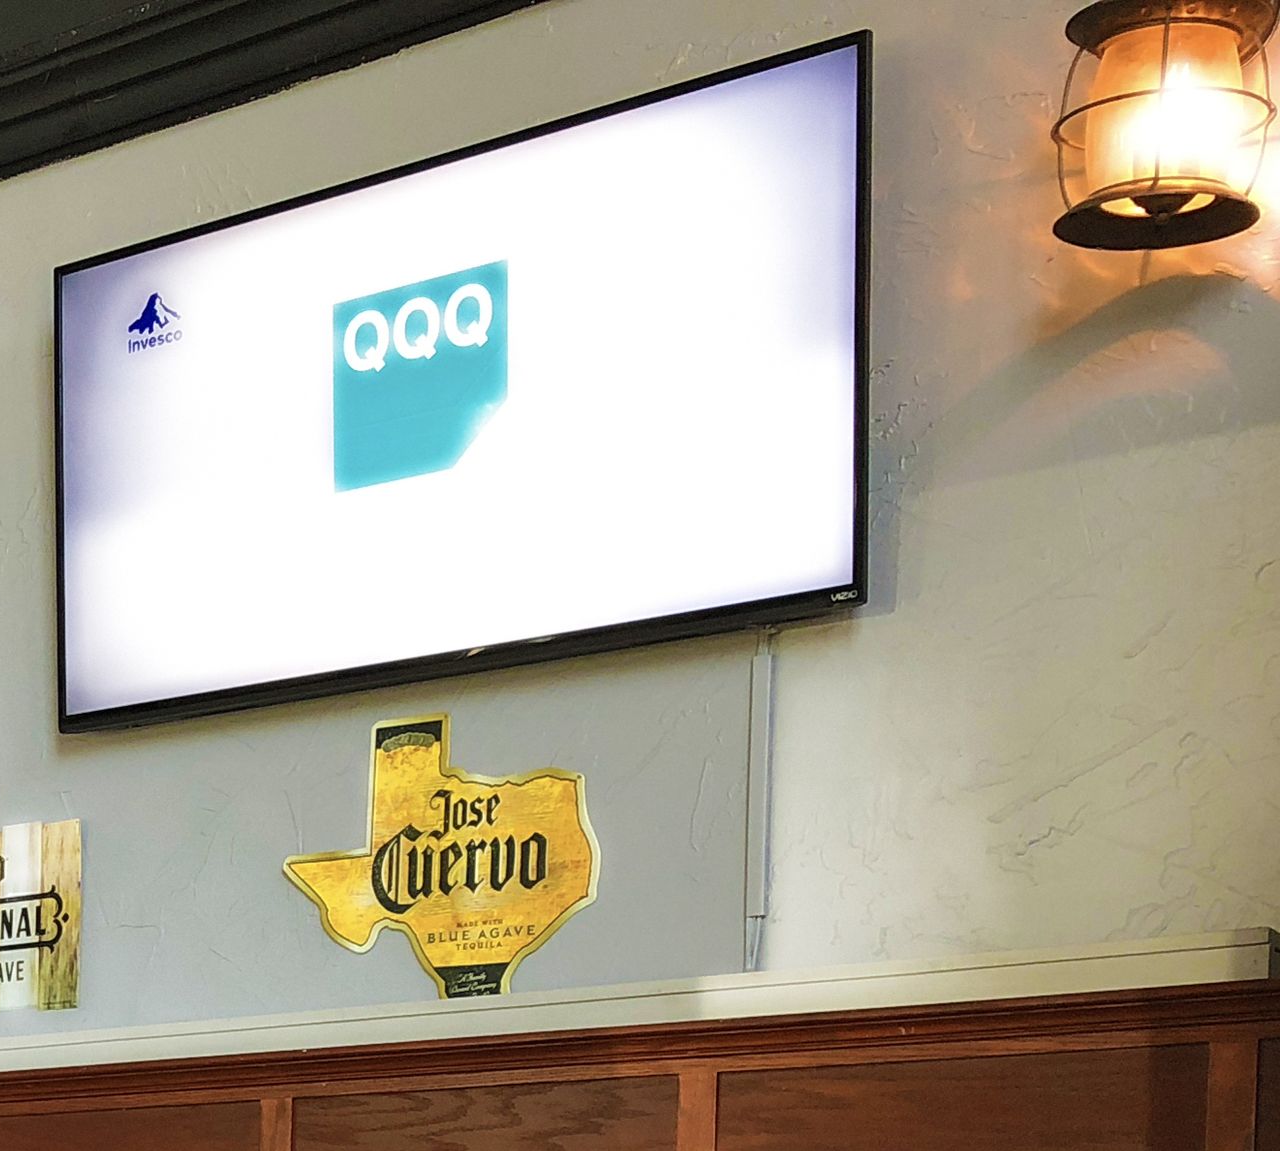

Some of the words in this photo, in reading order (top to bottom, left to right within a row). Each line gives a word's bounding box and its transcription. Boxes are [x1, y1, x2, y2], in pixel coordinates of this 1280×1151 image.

[343, 282, 494, 374] QQQ
[127, 329, 183, 354] Invesco
[830, 590, 858, 602] VIZIO
[428, 789, 501, 838] Jose
[371, 824, 547, 915] Cuervo
[427, 930, 471, 944] BLUE
[478, 925, 536, 940] AGAVE
[456, 920, 479, 929] MADE
[456, 941, 504, 951] TEQUILA
